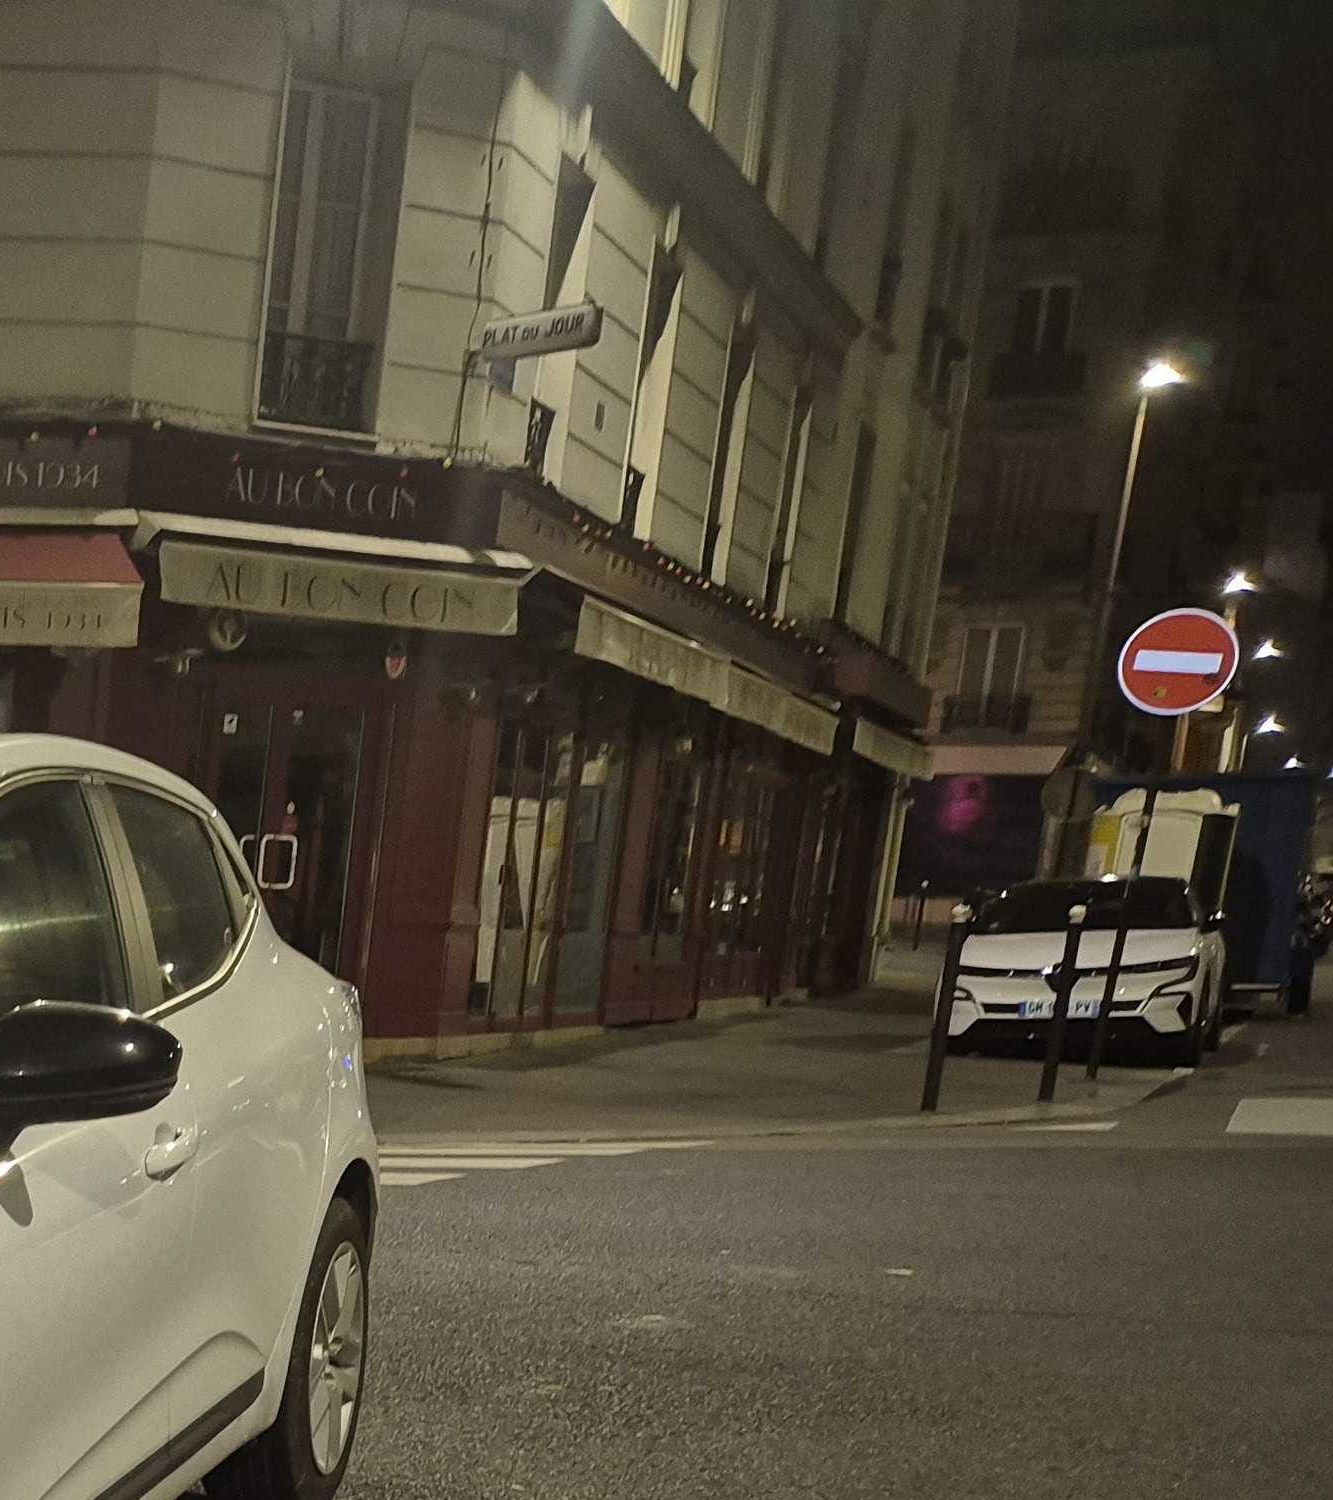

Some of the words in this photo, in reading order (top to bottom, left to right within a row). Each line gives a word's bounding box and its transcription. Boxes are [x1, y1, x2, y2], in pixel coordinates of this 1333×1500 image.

[483, 325, 518, 348] PLAT
[545, 313, 585, 337] JOUR
[38, 461, 100, 489] 1934
